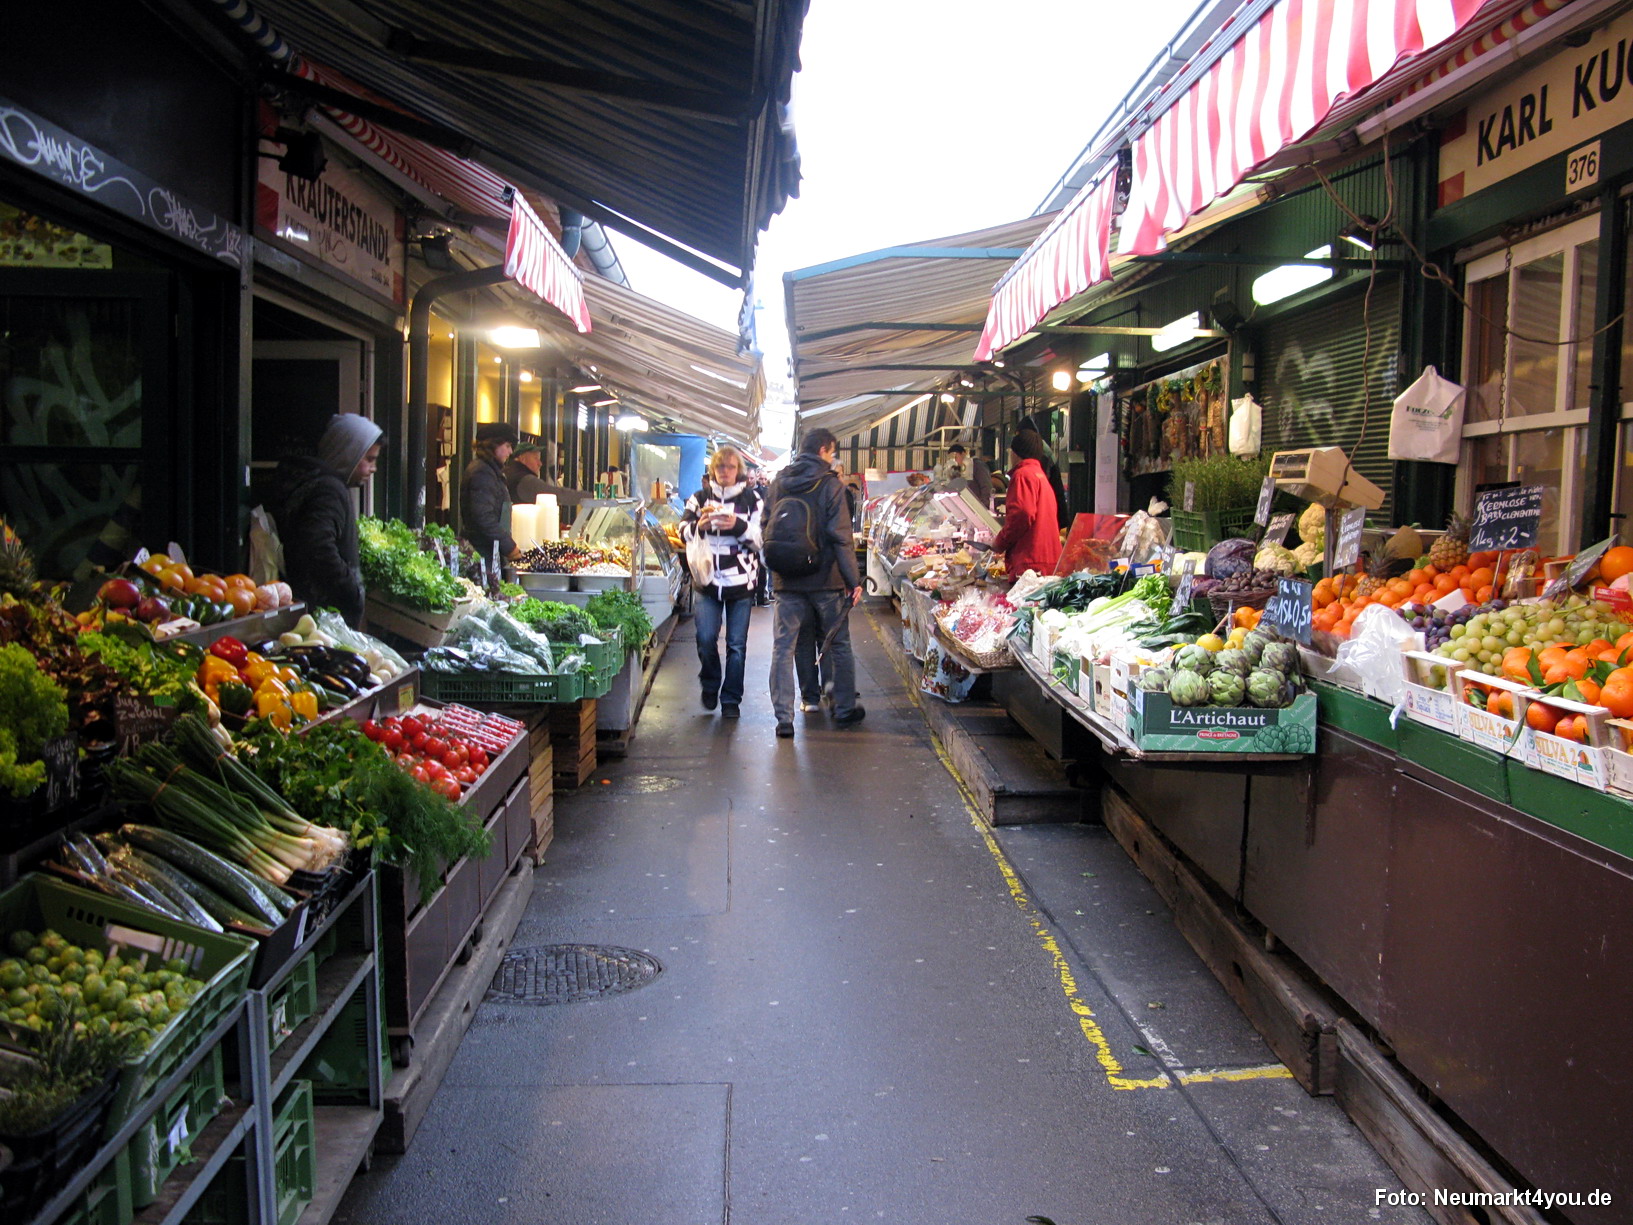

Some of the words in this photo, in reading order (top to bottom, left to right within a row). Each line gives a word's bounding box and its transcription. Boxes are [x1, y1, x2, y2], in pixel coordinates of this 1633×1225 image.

[1477, 84, 1553, 167] KARL
[1572, 39, 1633, 119] KU
[1568, 150, 1597, 185] 376
[1170, 709, 1265, 727] L'Artichaut
[1468, 710, 1496, 738] SILVA
[1535, 735, 1569, 763] SILVA
[1569, 747, 1578, 767] 2
